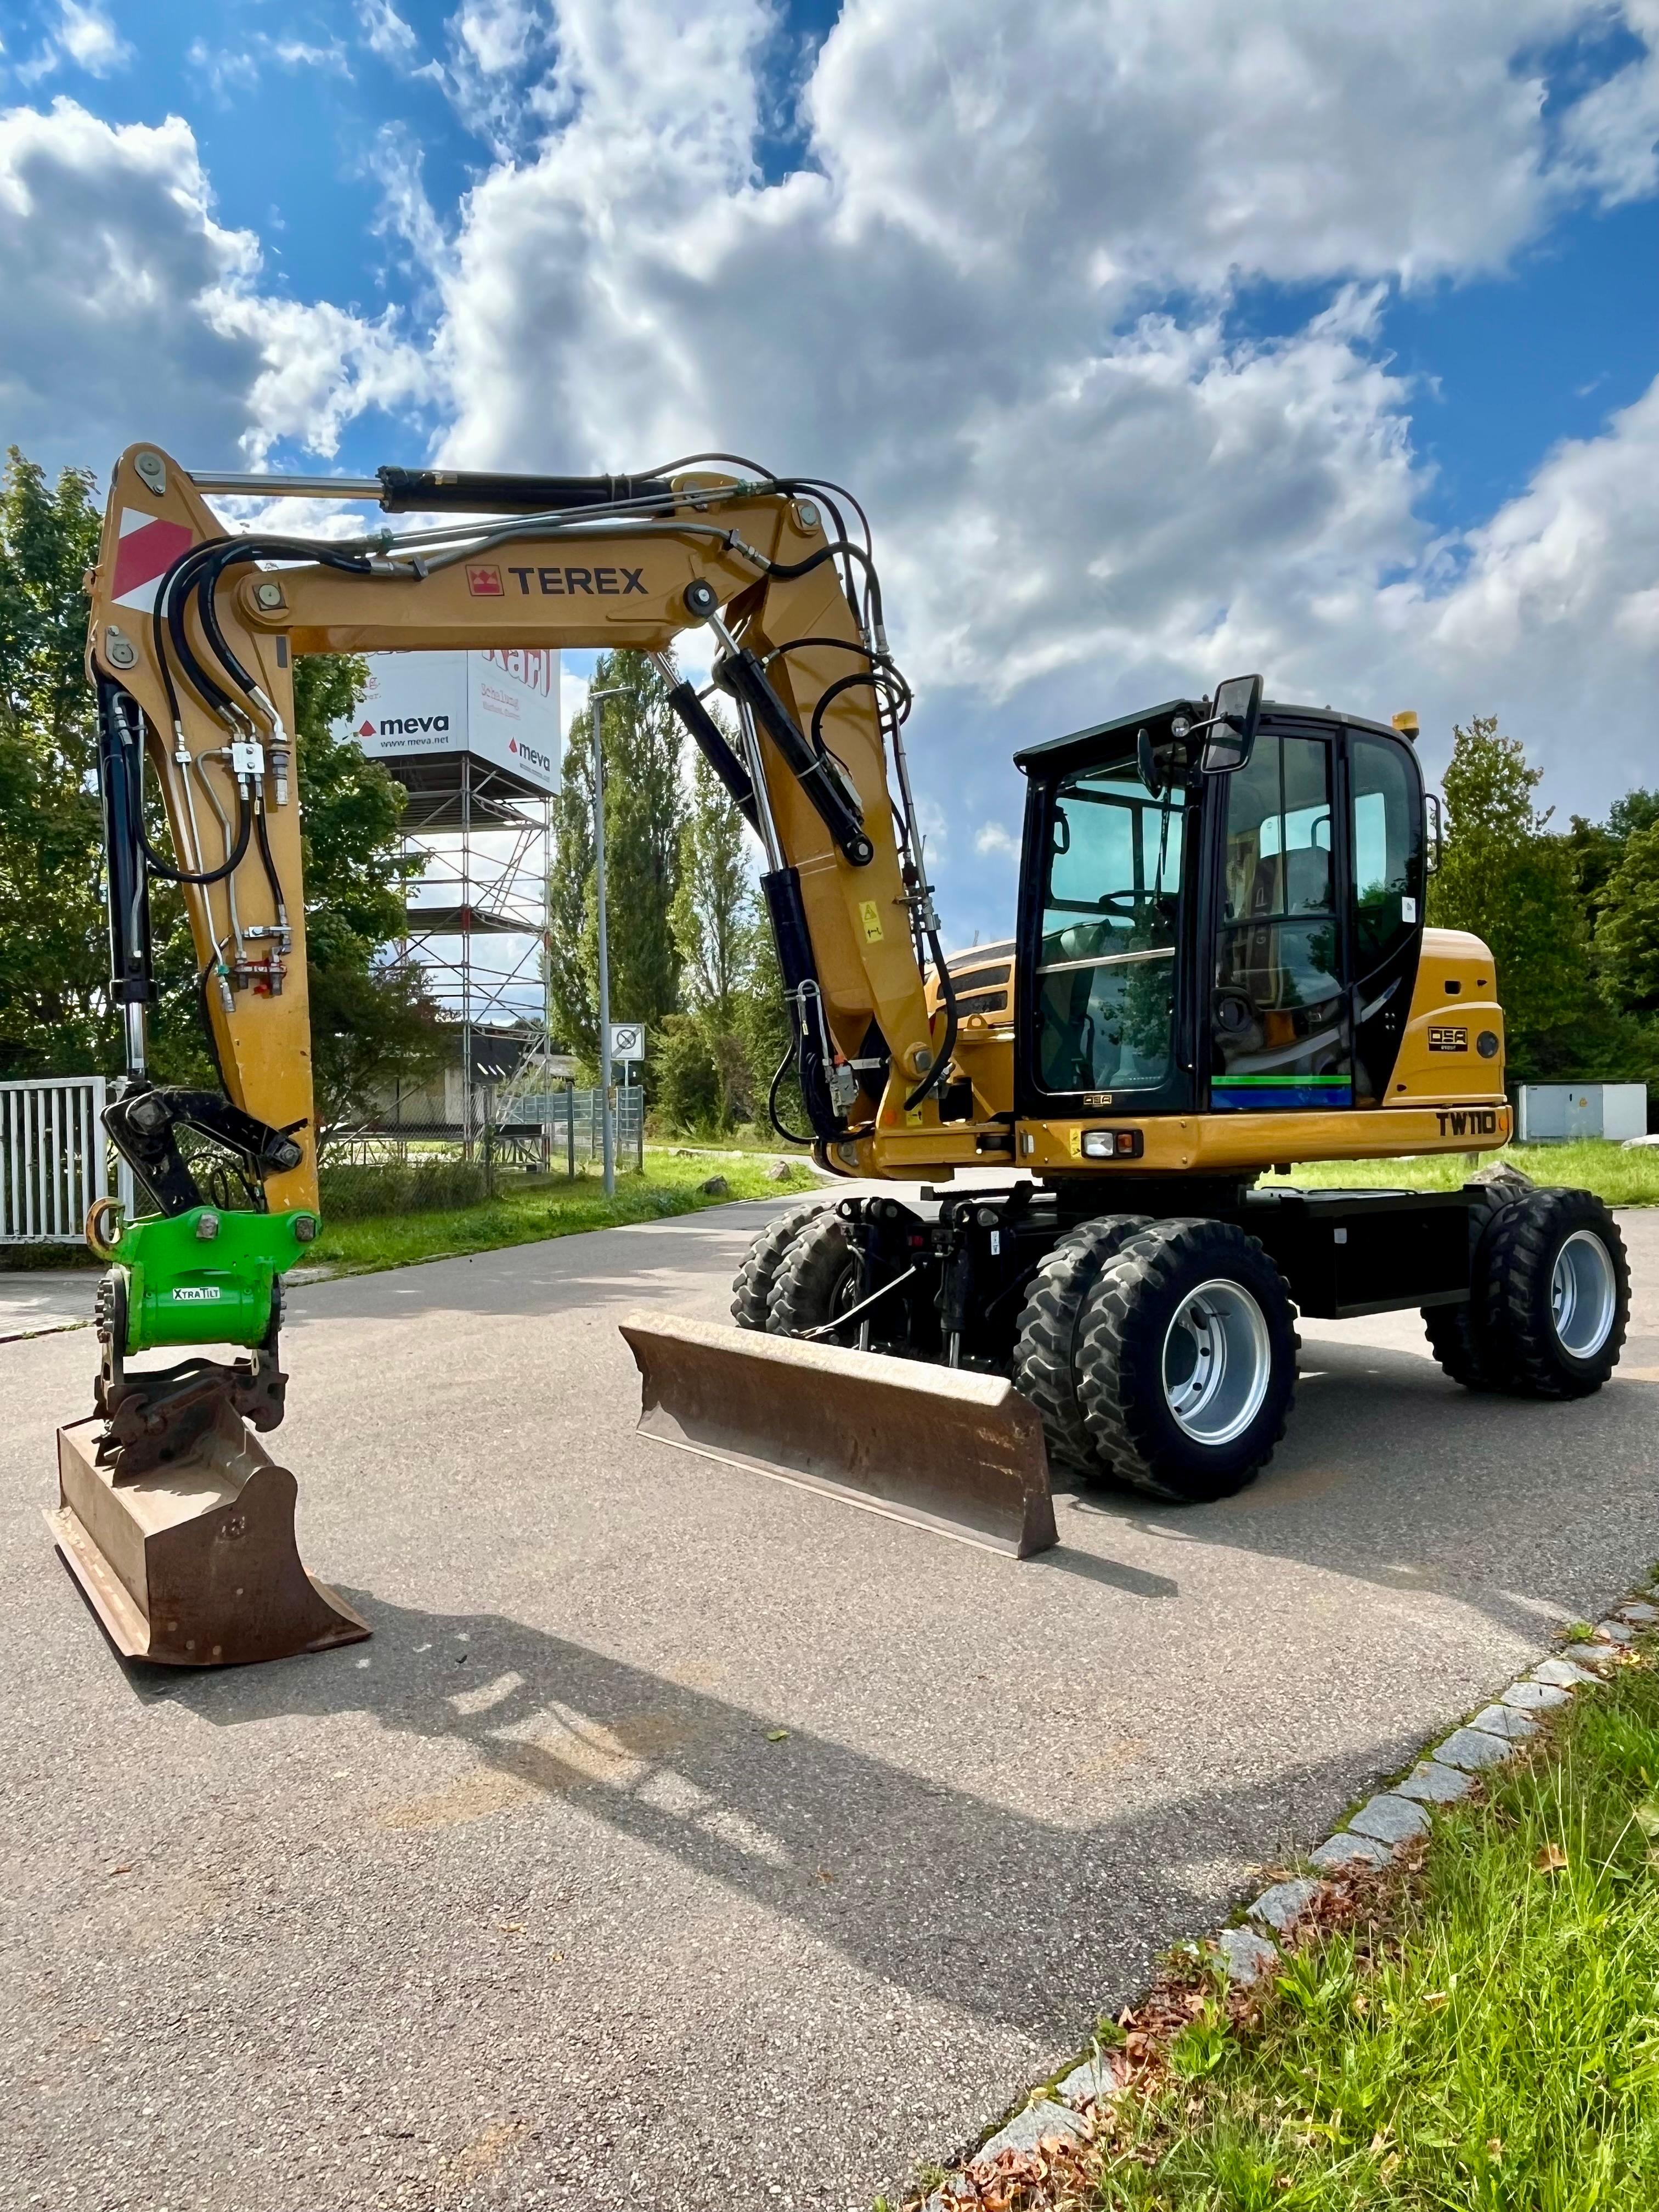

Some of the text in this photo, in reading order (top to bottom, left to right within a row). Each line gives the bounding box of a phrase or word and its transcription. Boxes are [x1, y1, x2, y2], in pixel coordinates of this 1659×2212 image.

[508, 567, 649, 595] TEREX
[380, 715, 449, 735] meva
[380, 736, 449, 747] www.meva.net
[519, 742, 550, 772] meva
[1436, 1111, 1496, 1136] TW110
